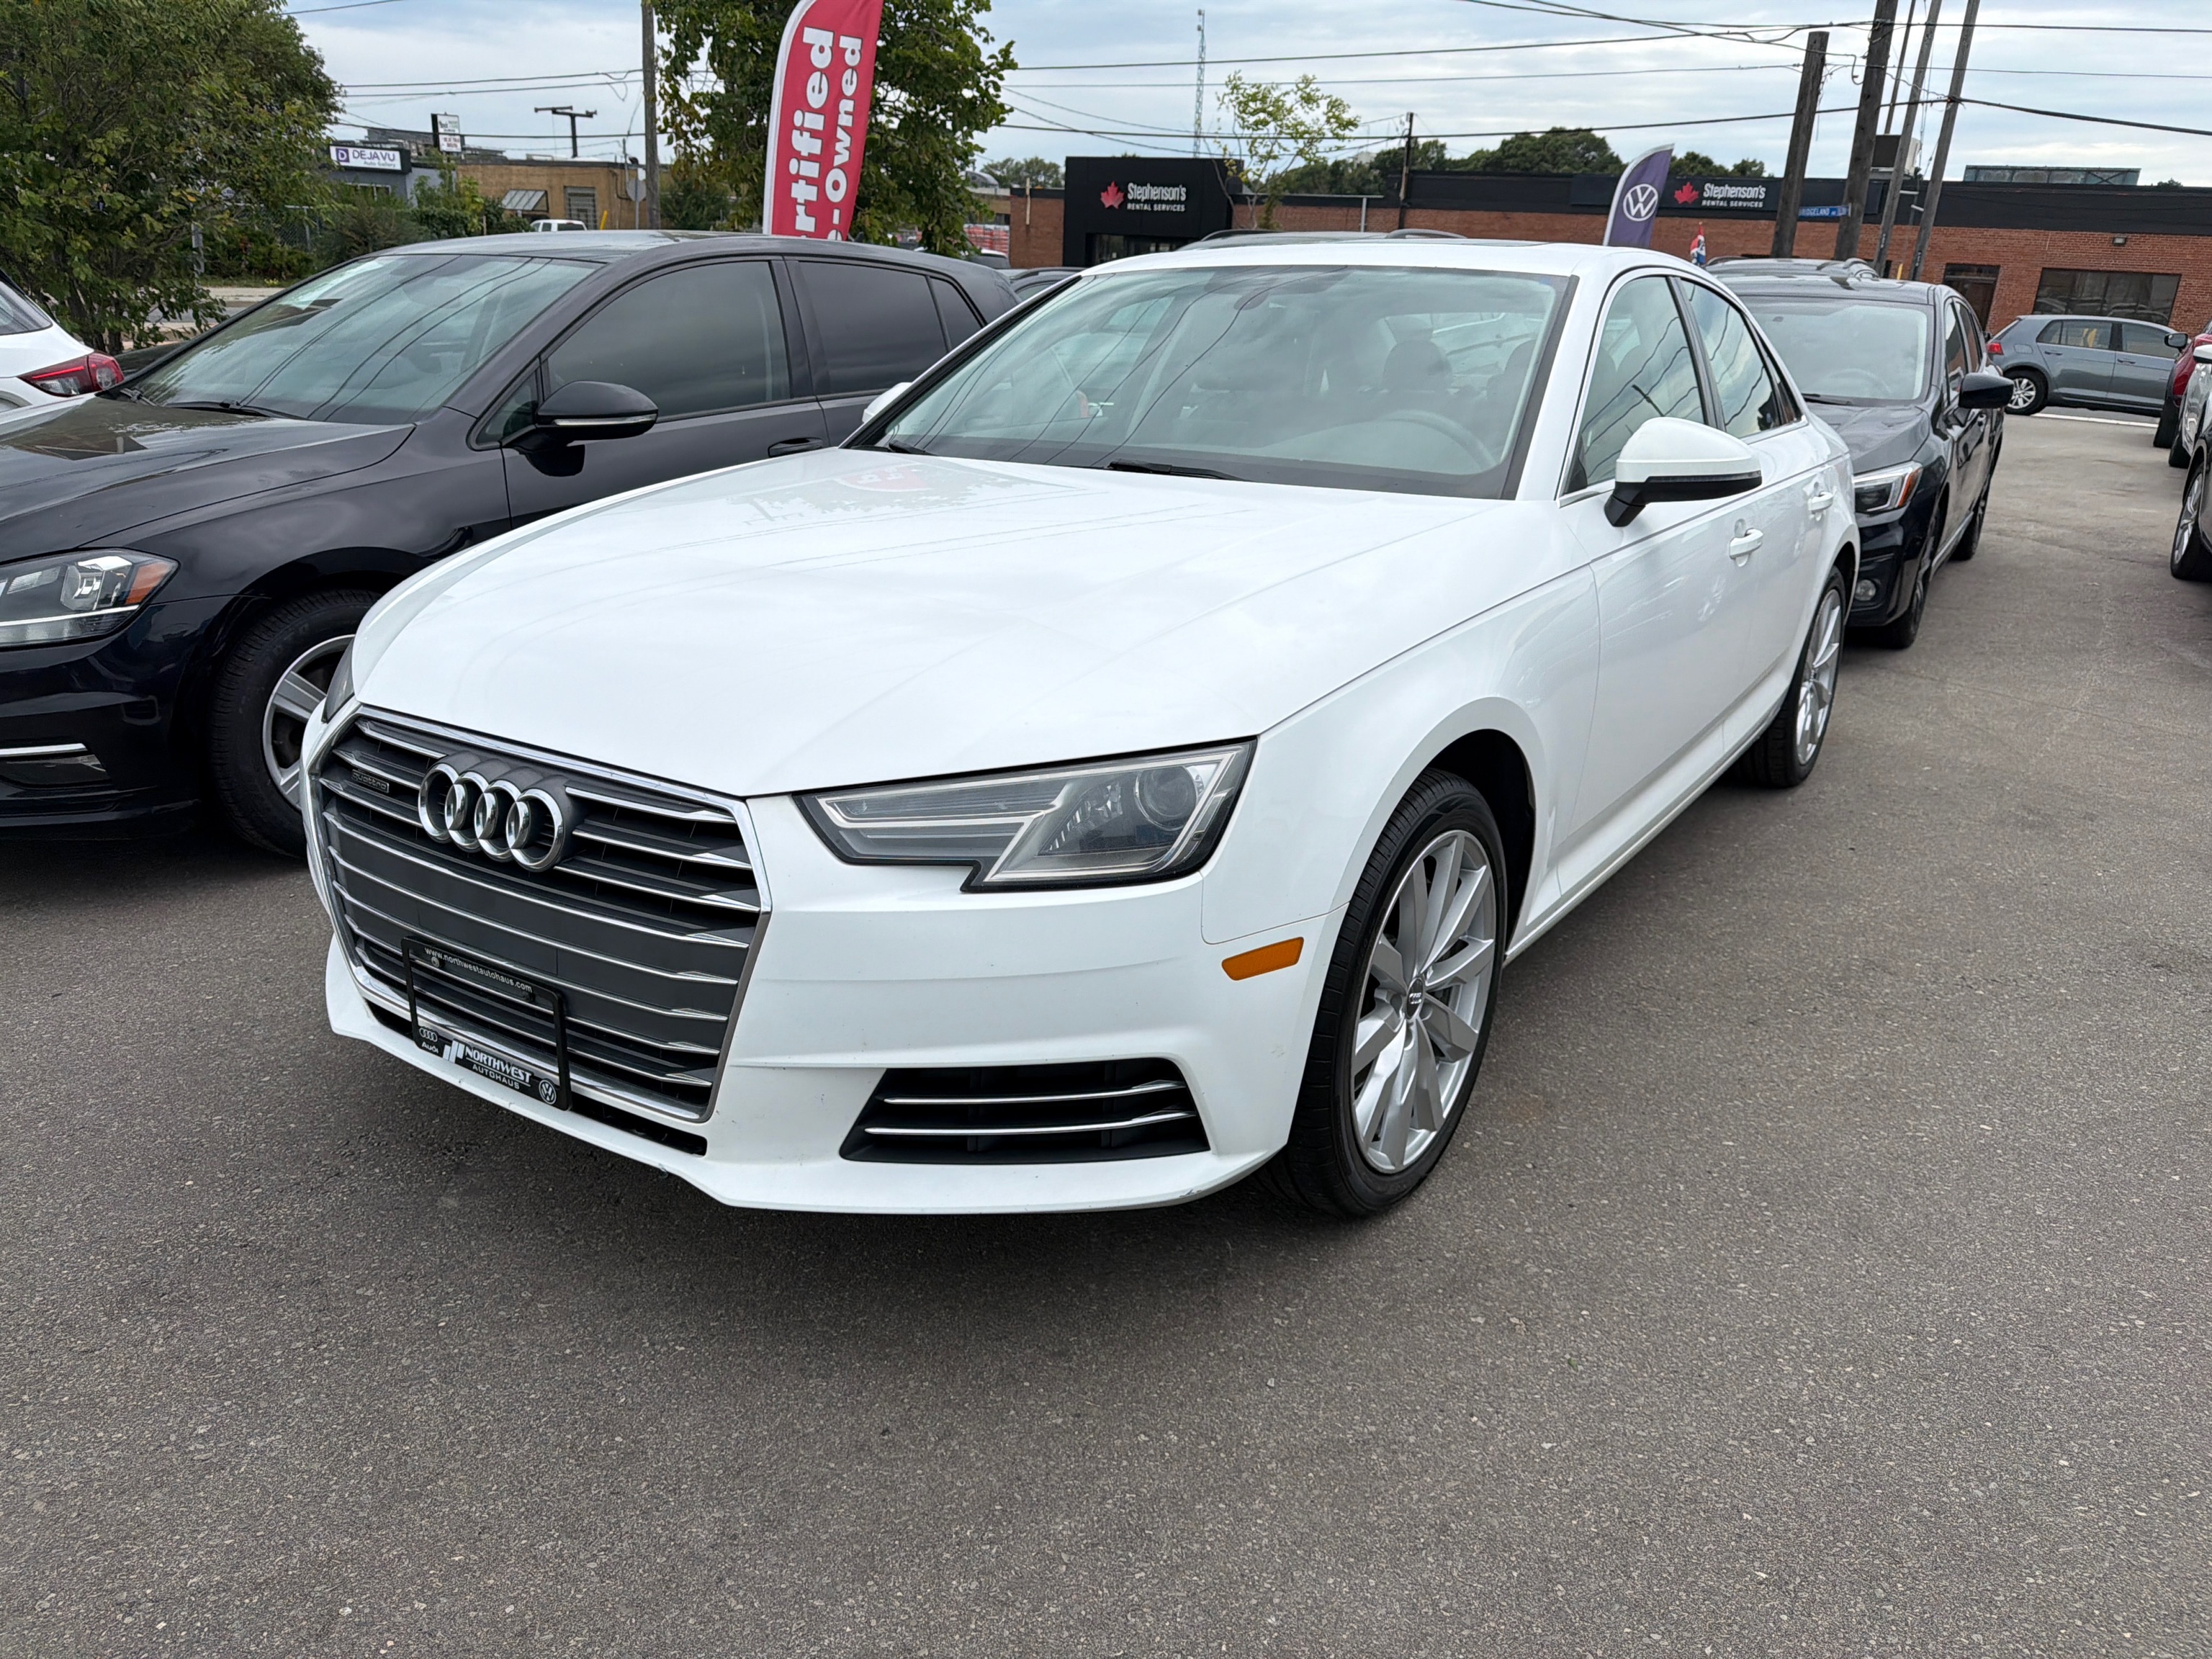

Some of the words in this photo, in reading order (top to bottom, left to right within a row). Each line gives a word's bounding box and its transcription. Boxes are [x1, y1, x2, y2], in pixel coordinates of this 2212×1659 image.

[788, 27, 835, 238] rtified
[1127, 182, 1187, 202] Stephenson's
[1703, 183, 1766, 199] Stephenson's
[1127, 202, 1151, 211] RENTAL
[1153, 203, 1185, 212] SERVICES
[352, 771, 387, 791] quattro
[424, 947, 533, 994] www.northwestautohaus.com
[464, 1046, 532, 1083] NORTHWEST
[472, 1064, 520, 1089] AUTOHAUS
